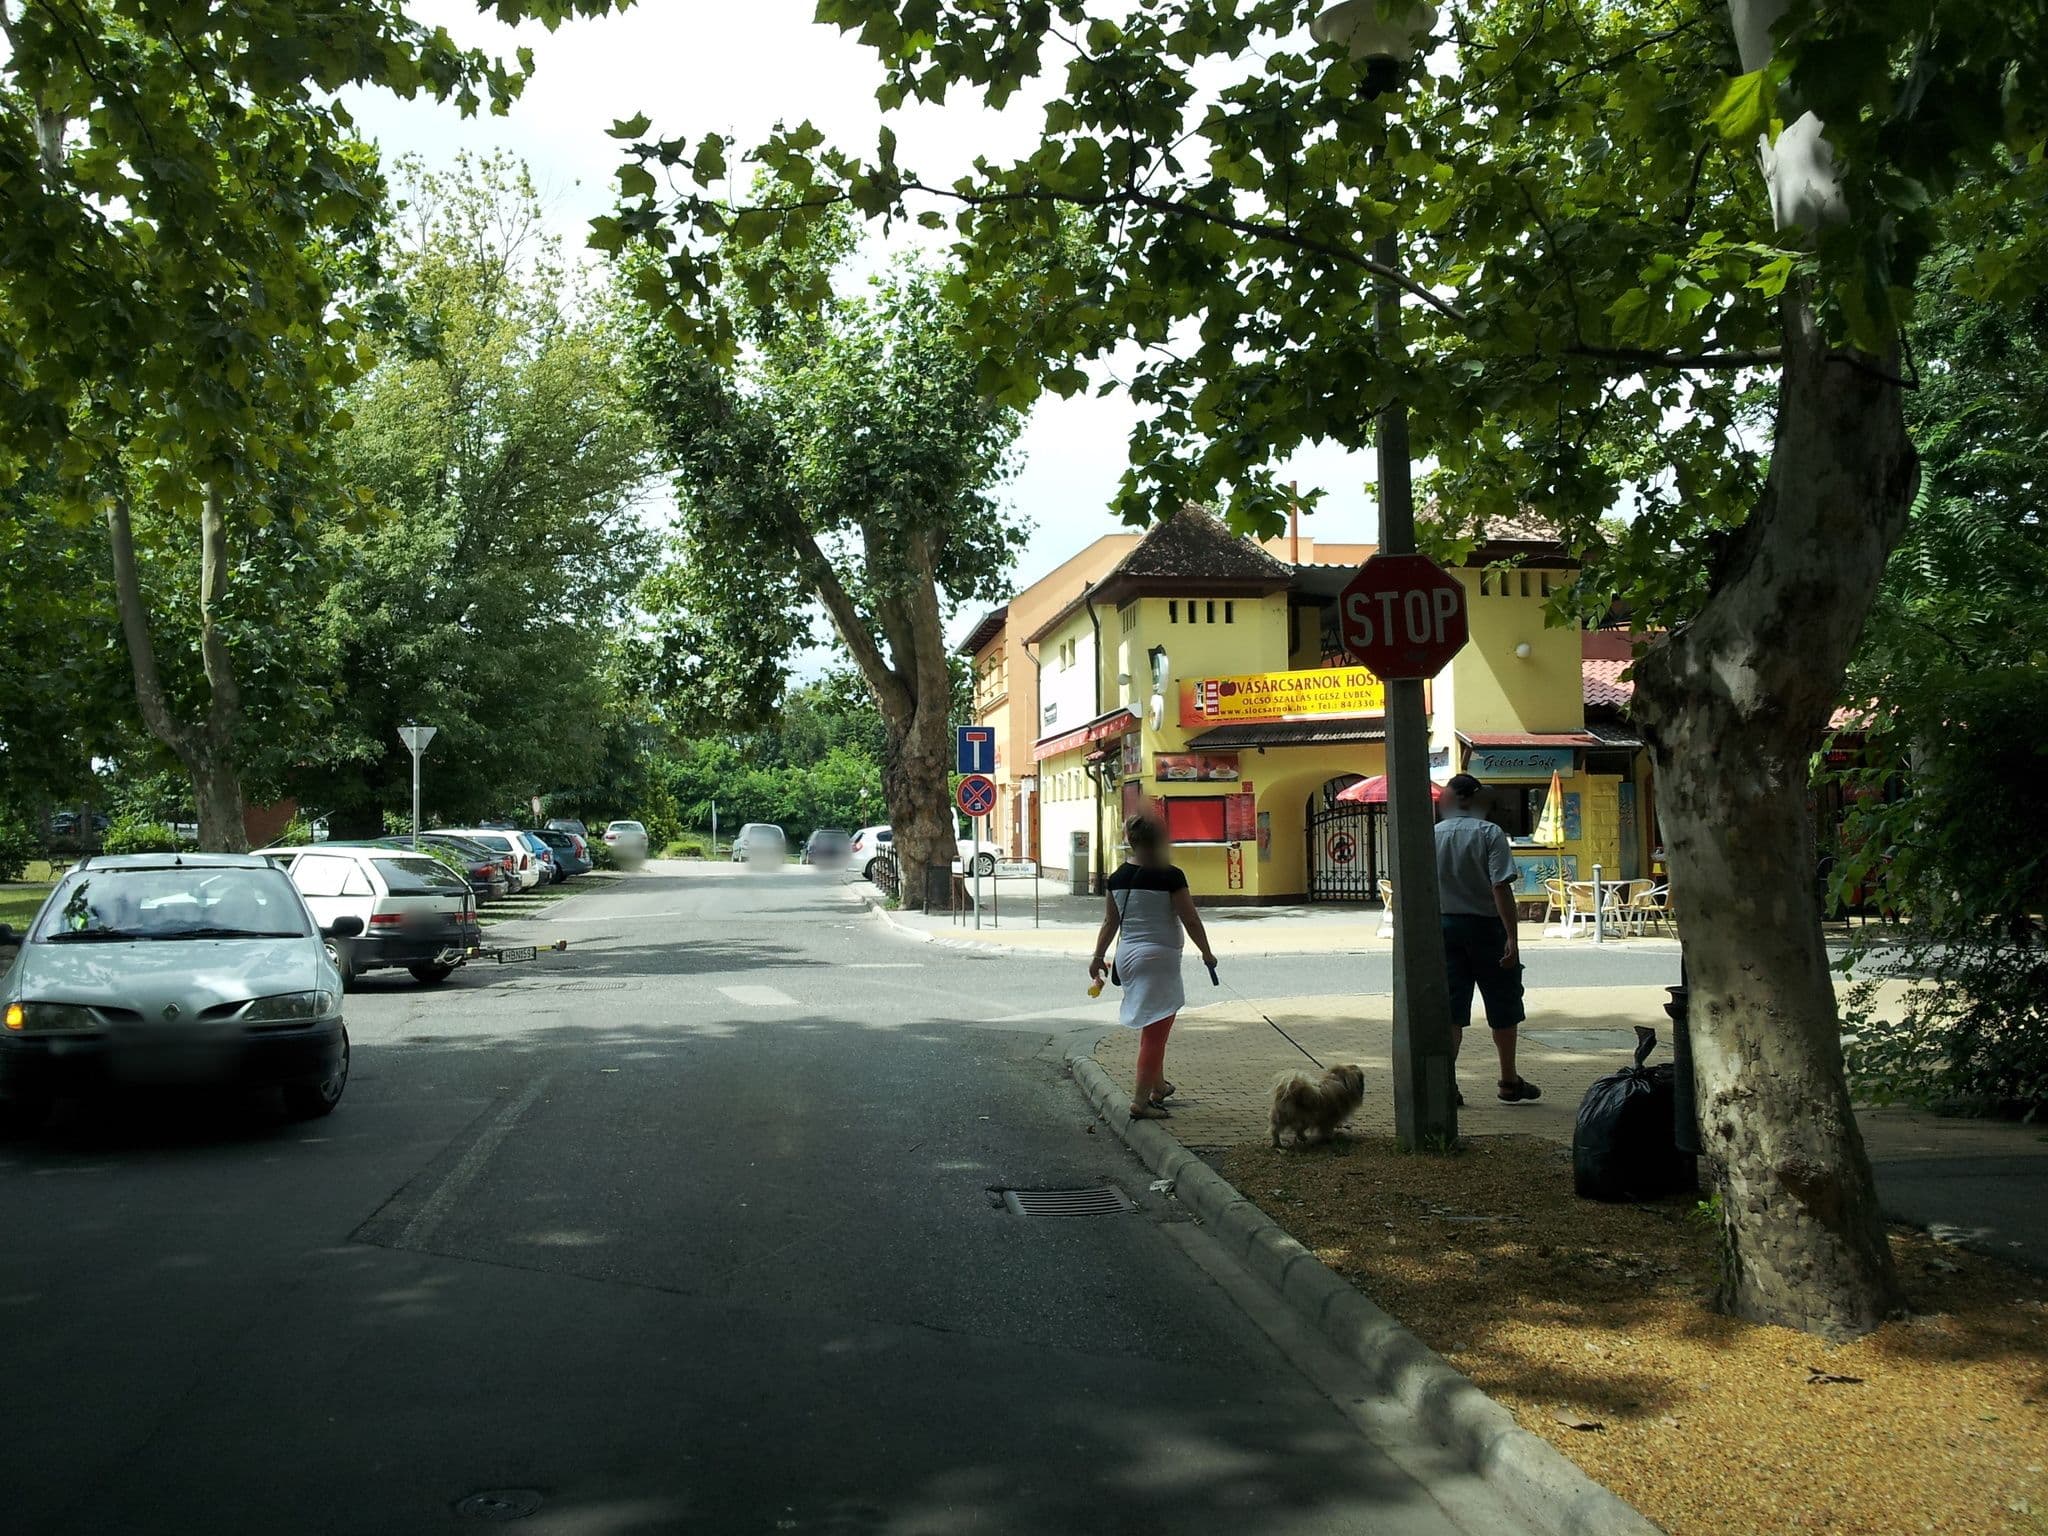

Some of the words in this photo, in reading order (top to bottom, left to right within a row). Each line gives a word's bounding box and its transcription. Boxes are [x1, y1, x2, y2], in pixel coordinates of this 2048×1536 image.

[1346, 588, 1458, 647] STOP
[1237, 674, 1341, 695] VÁSÁRCSARNOK
[1528, 754, 1557, 770] Soft
